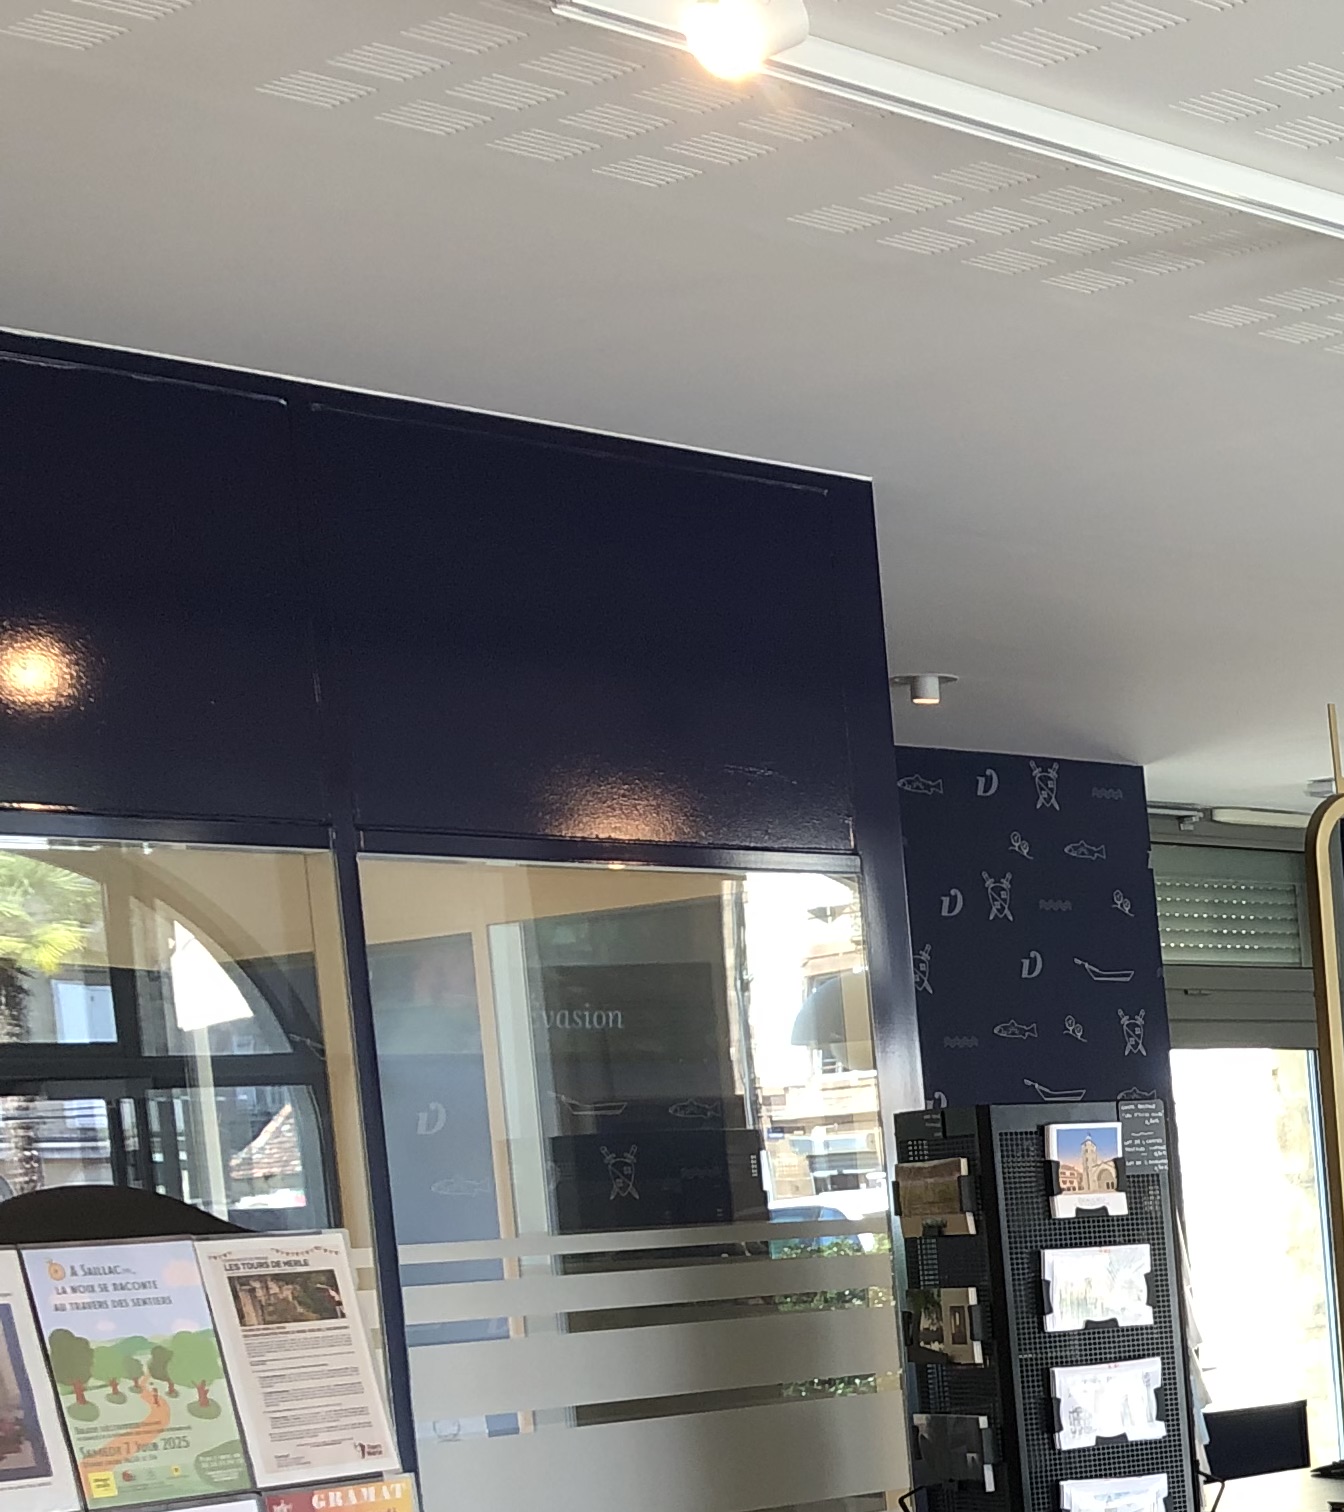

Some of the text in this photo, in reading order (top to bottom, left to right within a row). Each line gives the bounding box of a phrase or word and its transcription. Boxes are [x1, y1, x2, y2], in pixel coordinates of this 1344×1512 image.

[223, 1259, 309, 1272] LES TOURS DE MERLE
[55, 1286, 67, 1295] LA
[98, 1283, 110, 1292] SE
[112, 1280, 159, 1292] RACONTE
[53, 1296, 173, 1312] AU TRAVERS DES SENTIERS
[161, 1436, 190, 1450] 2025
[311, 1482, 407, 1509] GRAMAT
